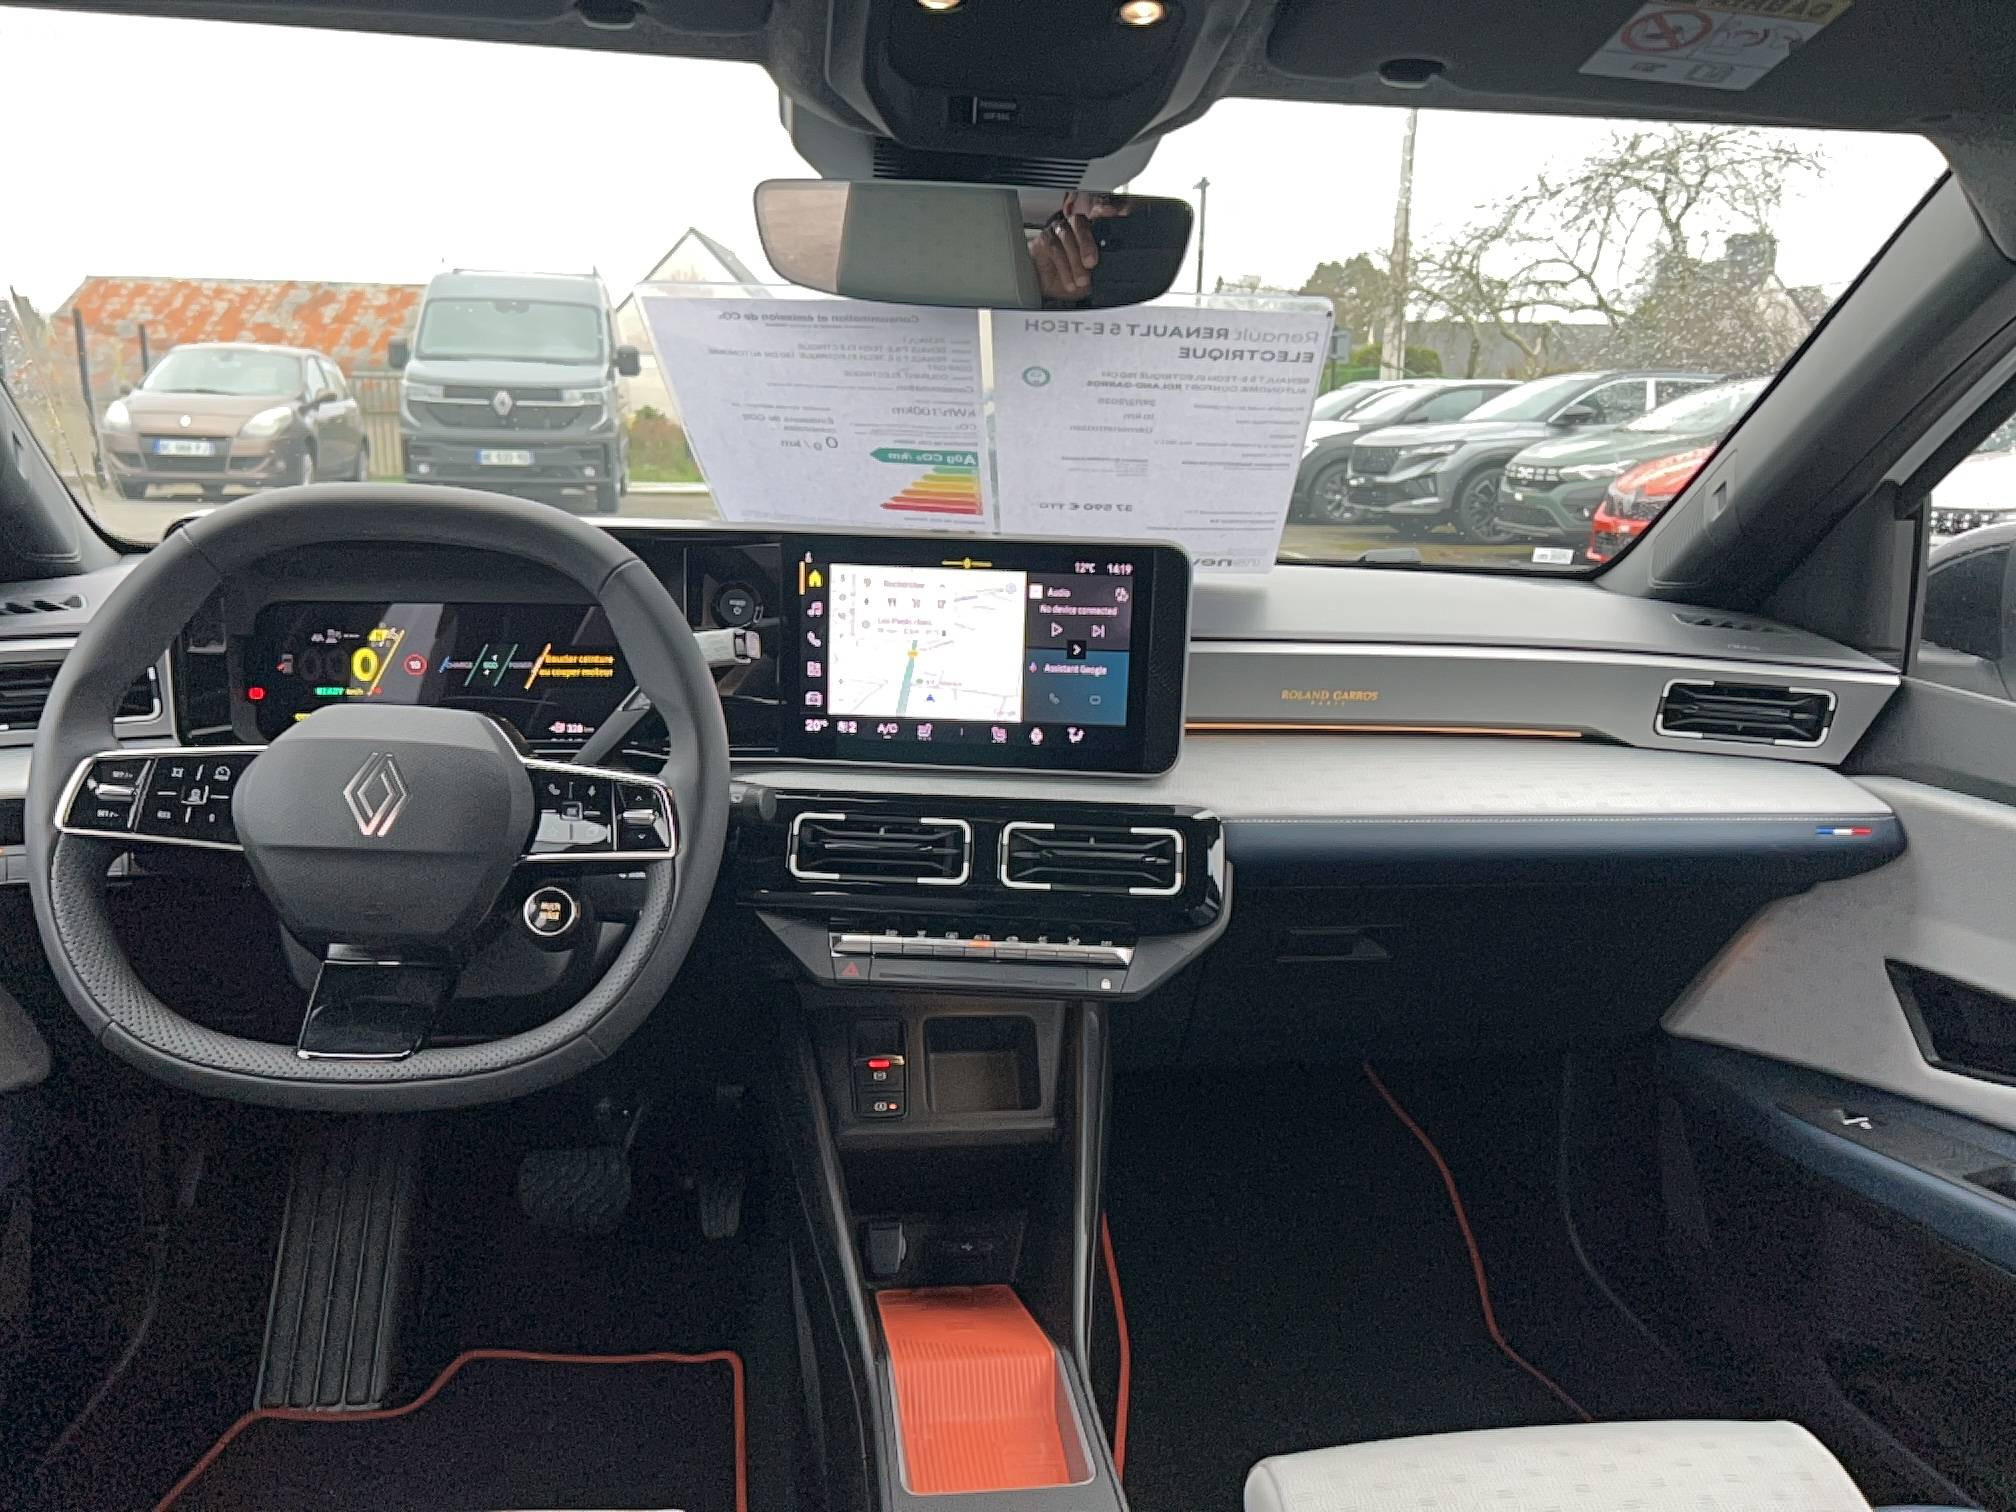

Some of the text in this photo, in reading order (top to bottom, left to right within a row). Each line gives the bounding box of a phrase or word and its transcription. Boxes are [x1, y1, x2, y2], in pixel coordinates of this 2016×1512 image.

[1047, 586, 1072, 598] Audio
[1077, 606, 1118, 616] connected
[351, 646, 379, 682] 0
[1044, 662, 1108, 677] Assistant Google
[1281, 689, 1379, 702] ROLAND GARROS
